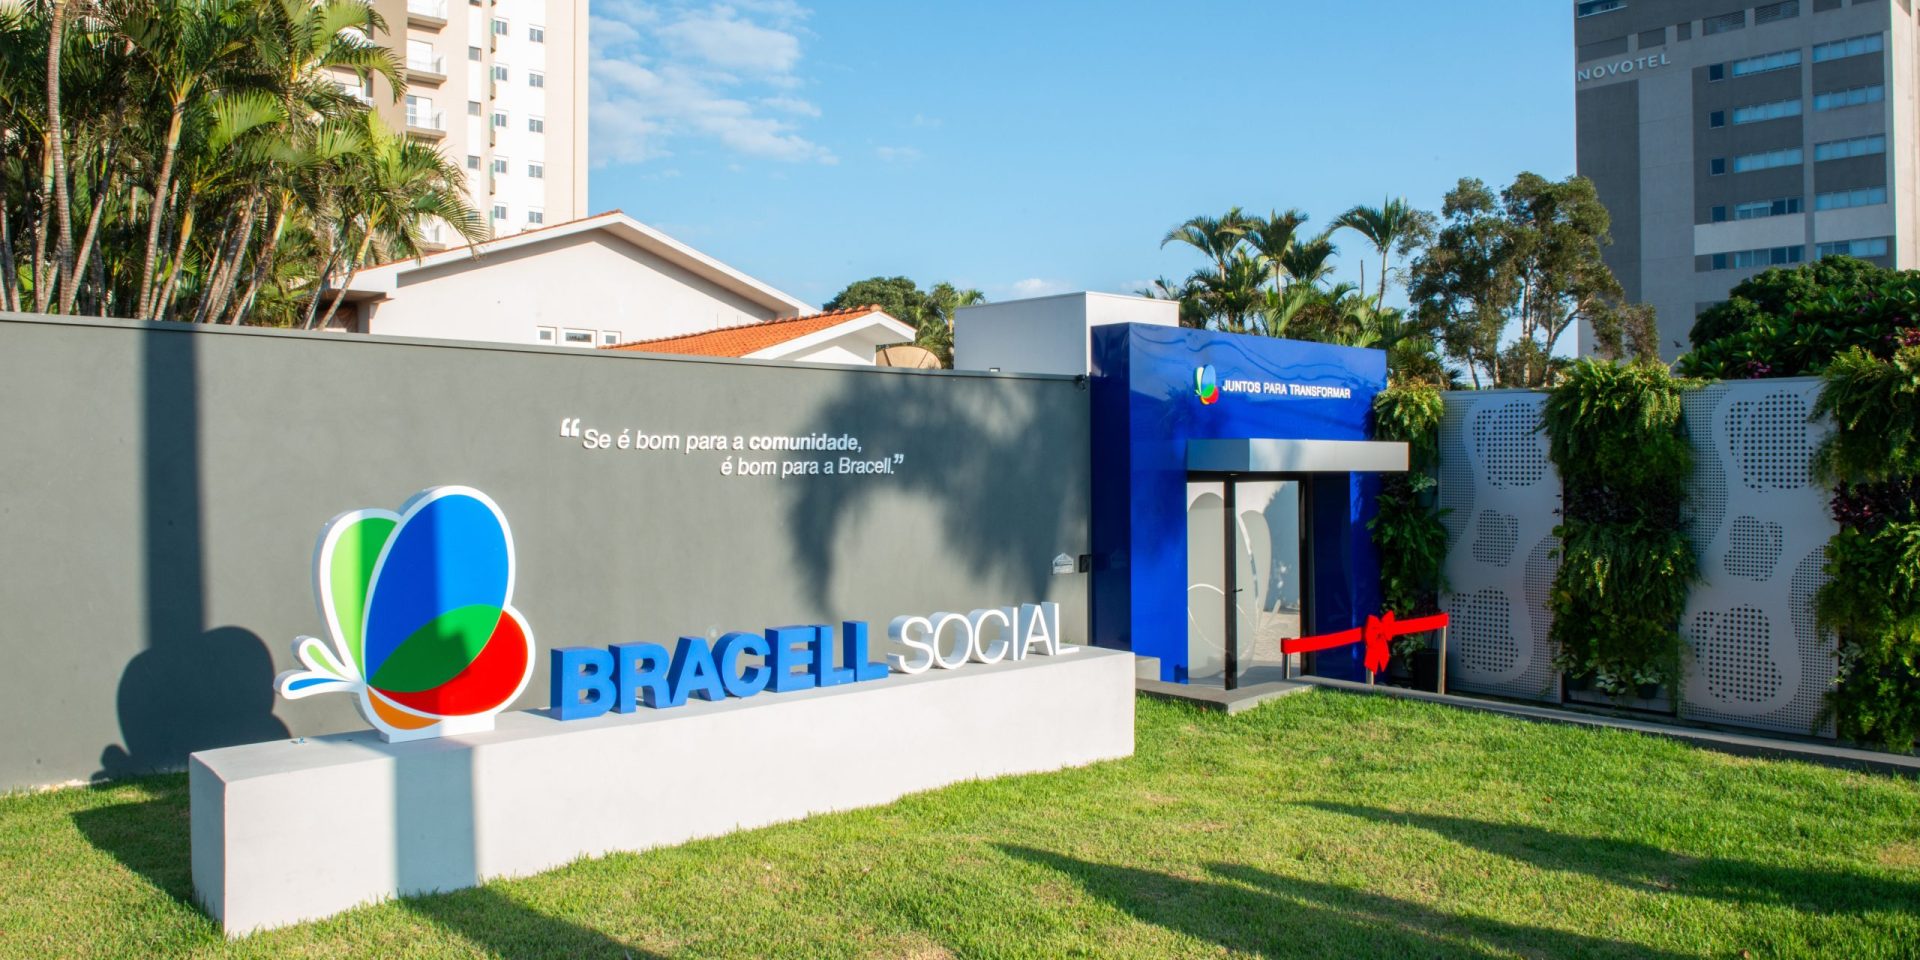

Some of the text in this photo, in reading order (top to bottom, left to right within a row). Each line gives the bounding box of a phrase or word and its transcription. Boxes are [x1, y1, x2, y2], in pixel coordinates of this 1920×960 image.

[1577, 53, 1671, 82] NOVOTEL
[1222, 380, 1351, 399] JUNTOS PARA TRANSFORMAR
[617, 428, 631, 449] é
[636, 430, 680, 450] bom
[685, 434, 727, 454] para
[732, 435, 744, 450] a
[749, 433, 862, 453] comunidade,
[720, 456, 733, 475] é
[737, 458, 777, 475] bom
[781, 461, 819, 479] para
[823, 461, 834, 475] a
[550, 602, 1080, 721] BRACELL SOCIAL
